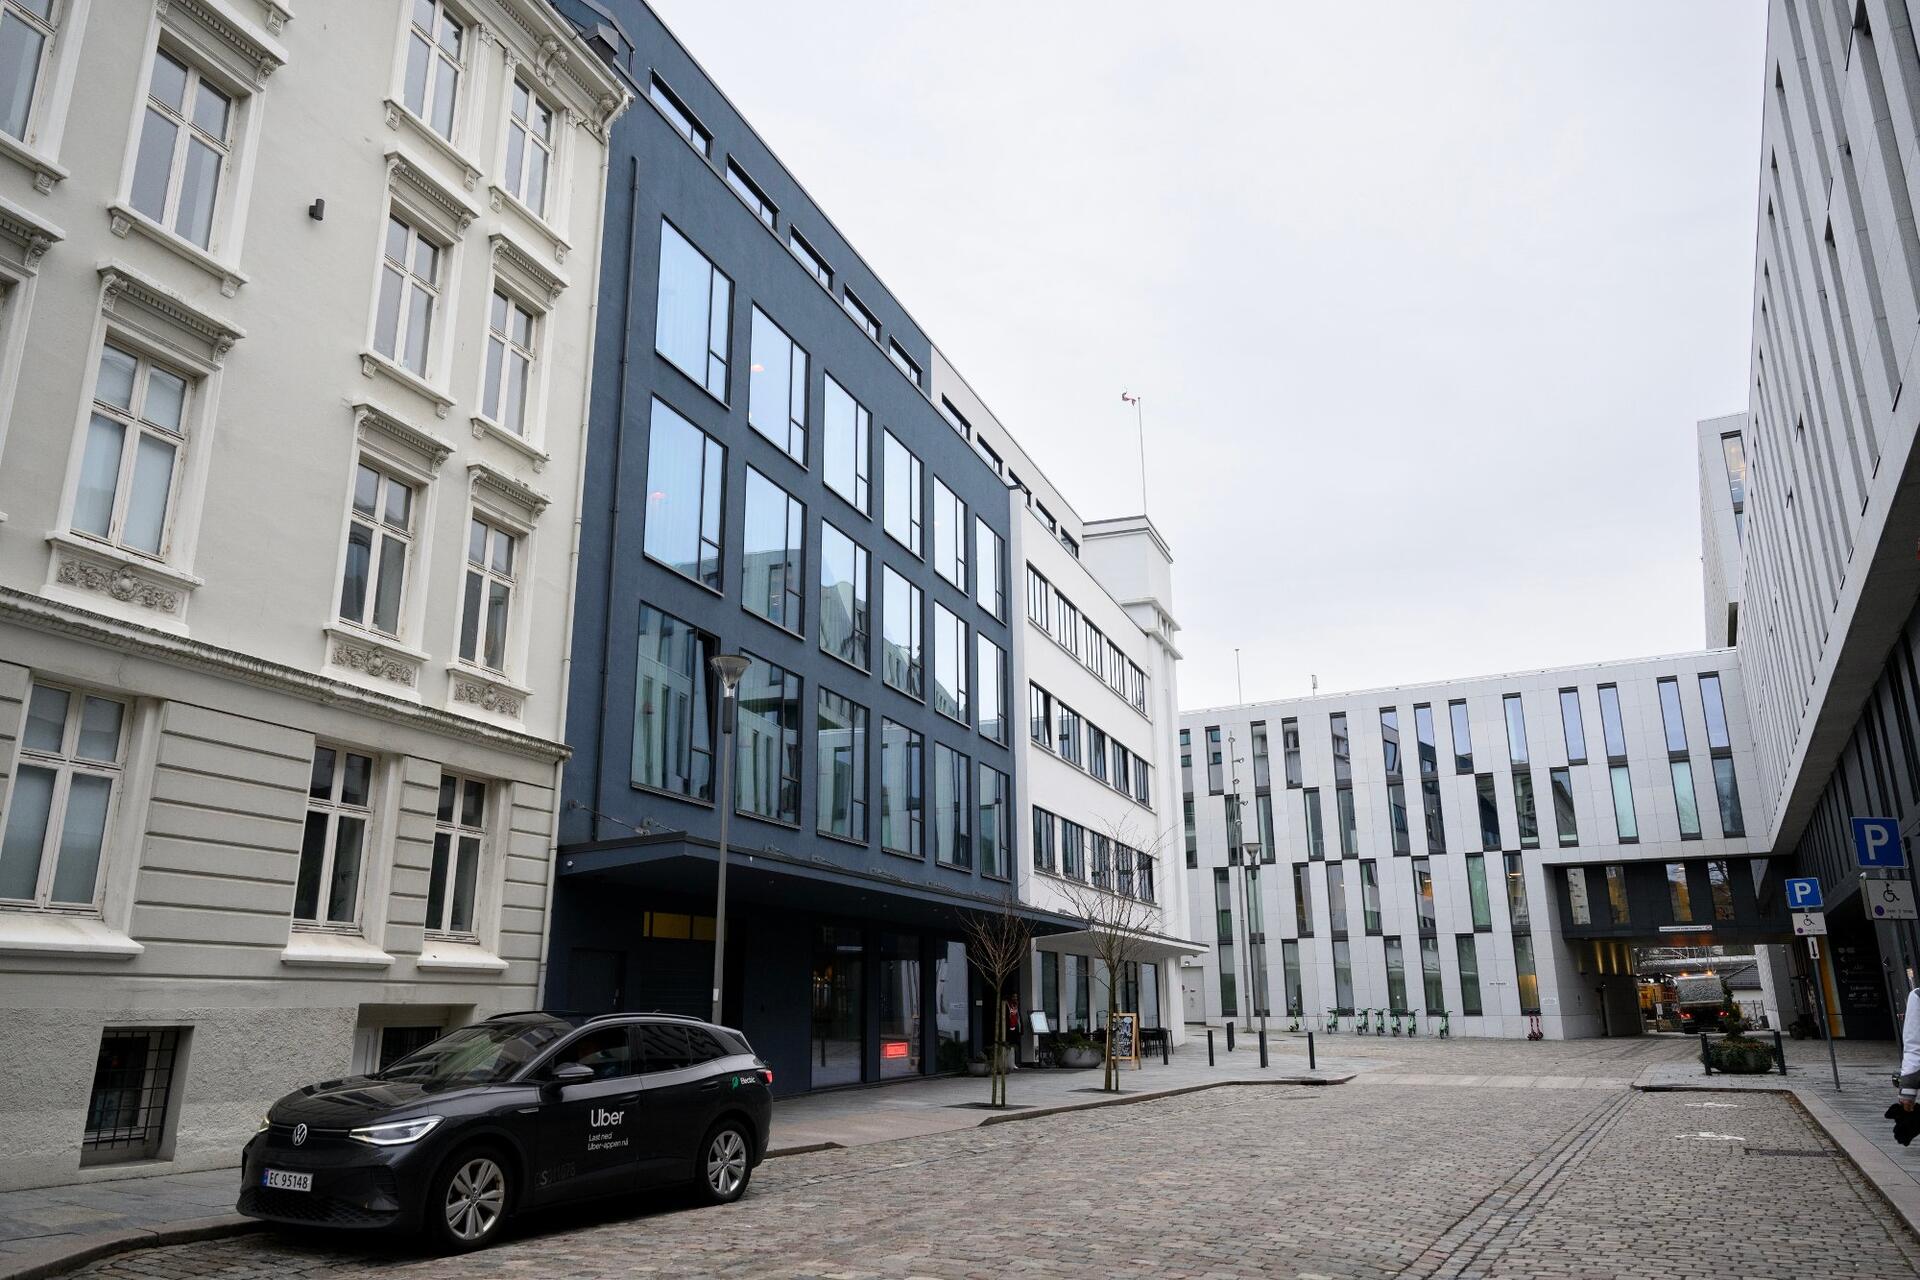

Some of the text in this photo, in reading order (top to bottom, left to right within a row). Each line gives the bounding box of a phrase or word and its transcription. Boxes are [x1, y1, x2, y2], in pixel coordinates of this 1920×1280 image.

[1863, 824, 1889, 860] P
[1794, 882, 1812, 903] P
[591, 1108, 625, 1127] Uber
[587, 1140, 621, 1151] Uber-appen
[588, 1131, 613, 1142] Last ned
[269, 1172, 308, 1189] EC 95148
